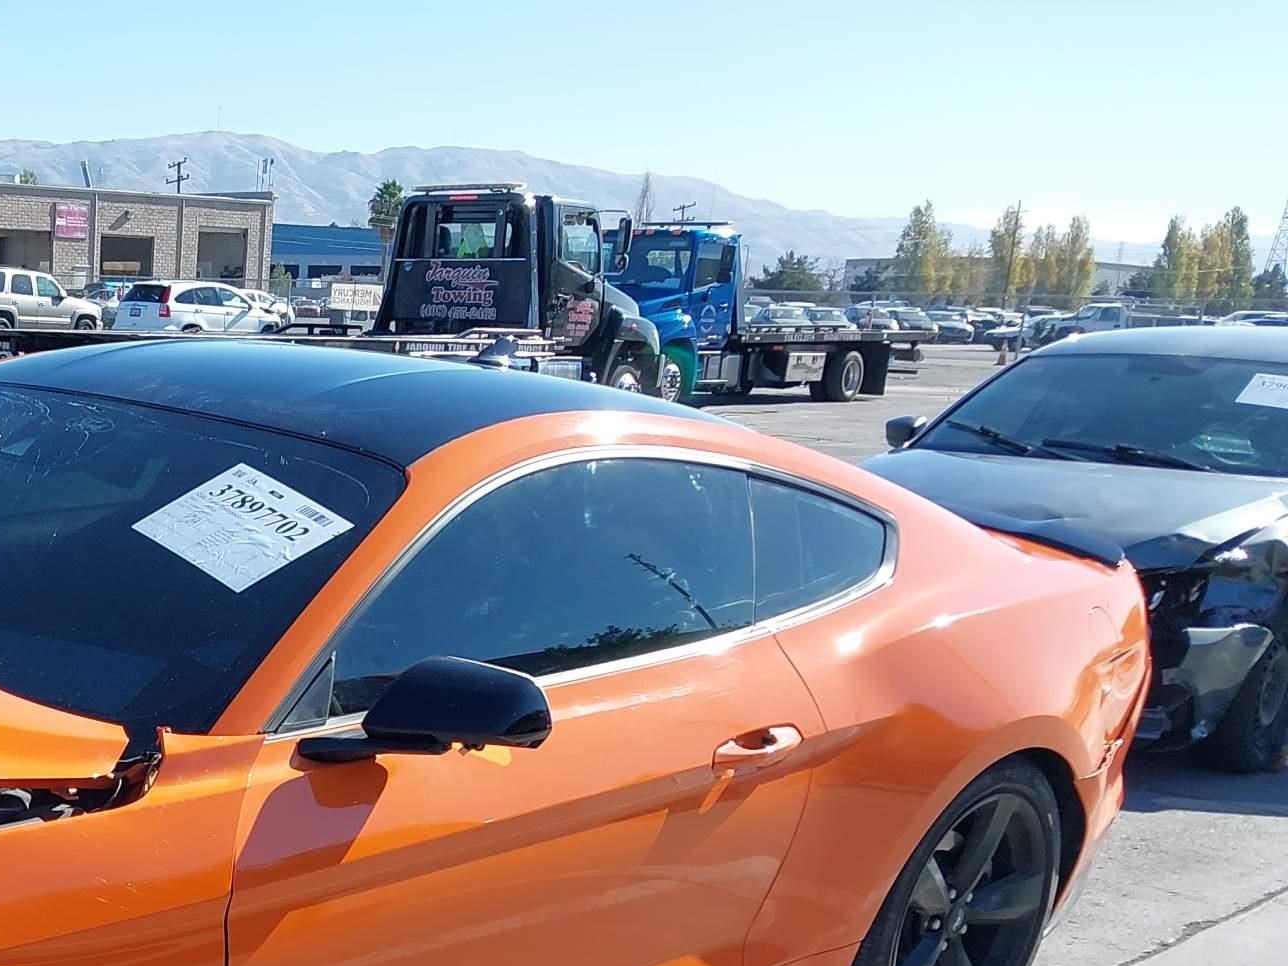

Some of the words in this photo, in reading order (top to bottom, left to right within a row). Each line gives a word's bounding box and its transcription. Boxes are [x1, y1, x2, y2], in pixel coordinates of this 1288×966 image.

[425, 260, 494, 285] Jarquin
[431, 287, 493, 306] Towing
[420, 304, 447, 318] (408)
[209, 484, 310, 541] 37897702
